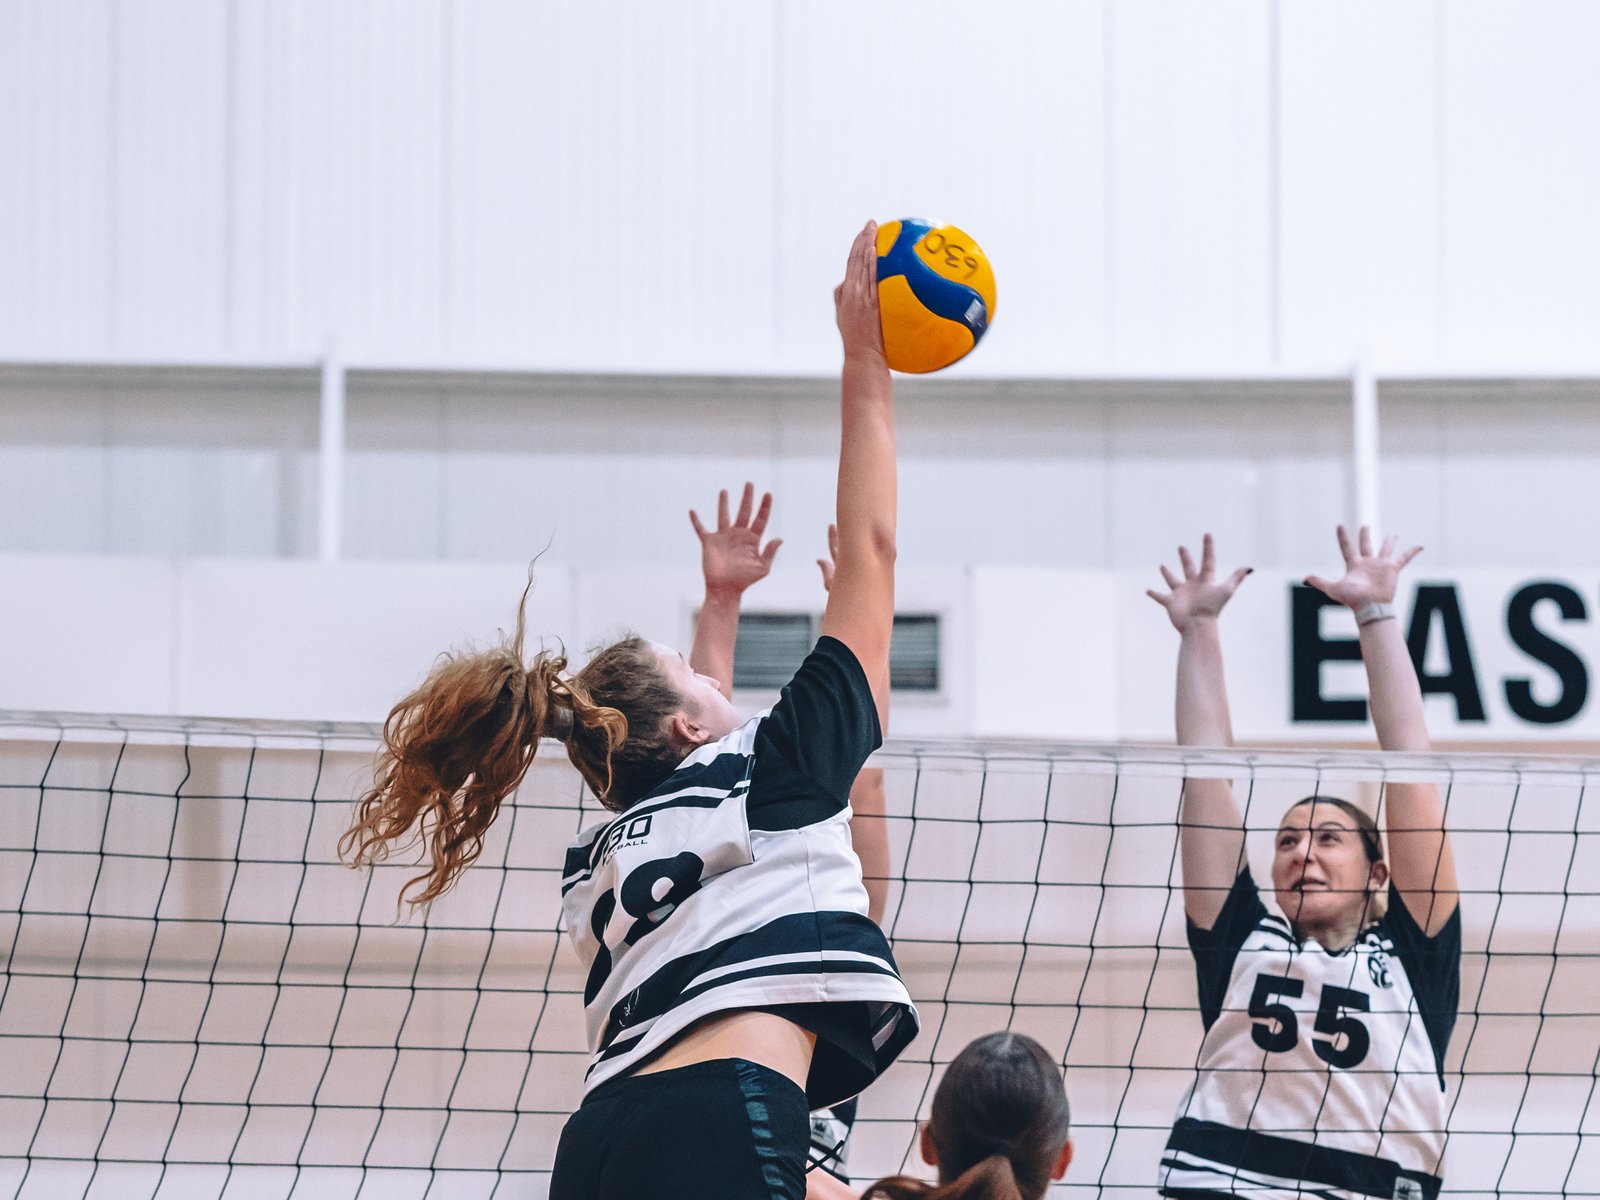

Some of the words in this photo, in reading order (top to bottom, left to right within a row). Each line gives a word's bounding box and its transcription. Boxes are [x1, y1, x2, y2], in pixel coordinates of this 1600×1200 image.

[1290, 582, 1600, 723] EAS
[602, 815, 653, 867] 30
[1248, 973, 1370, 1069] 55
